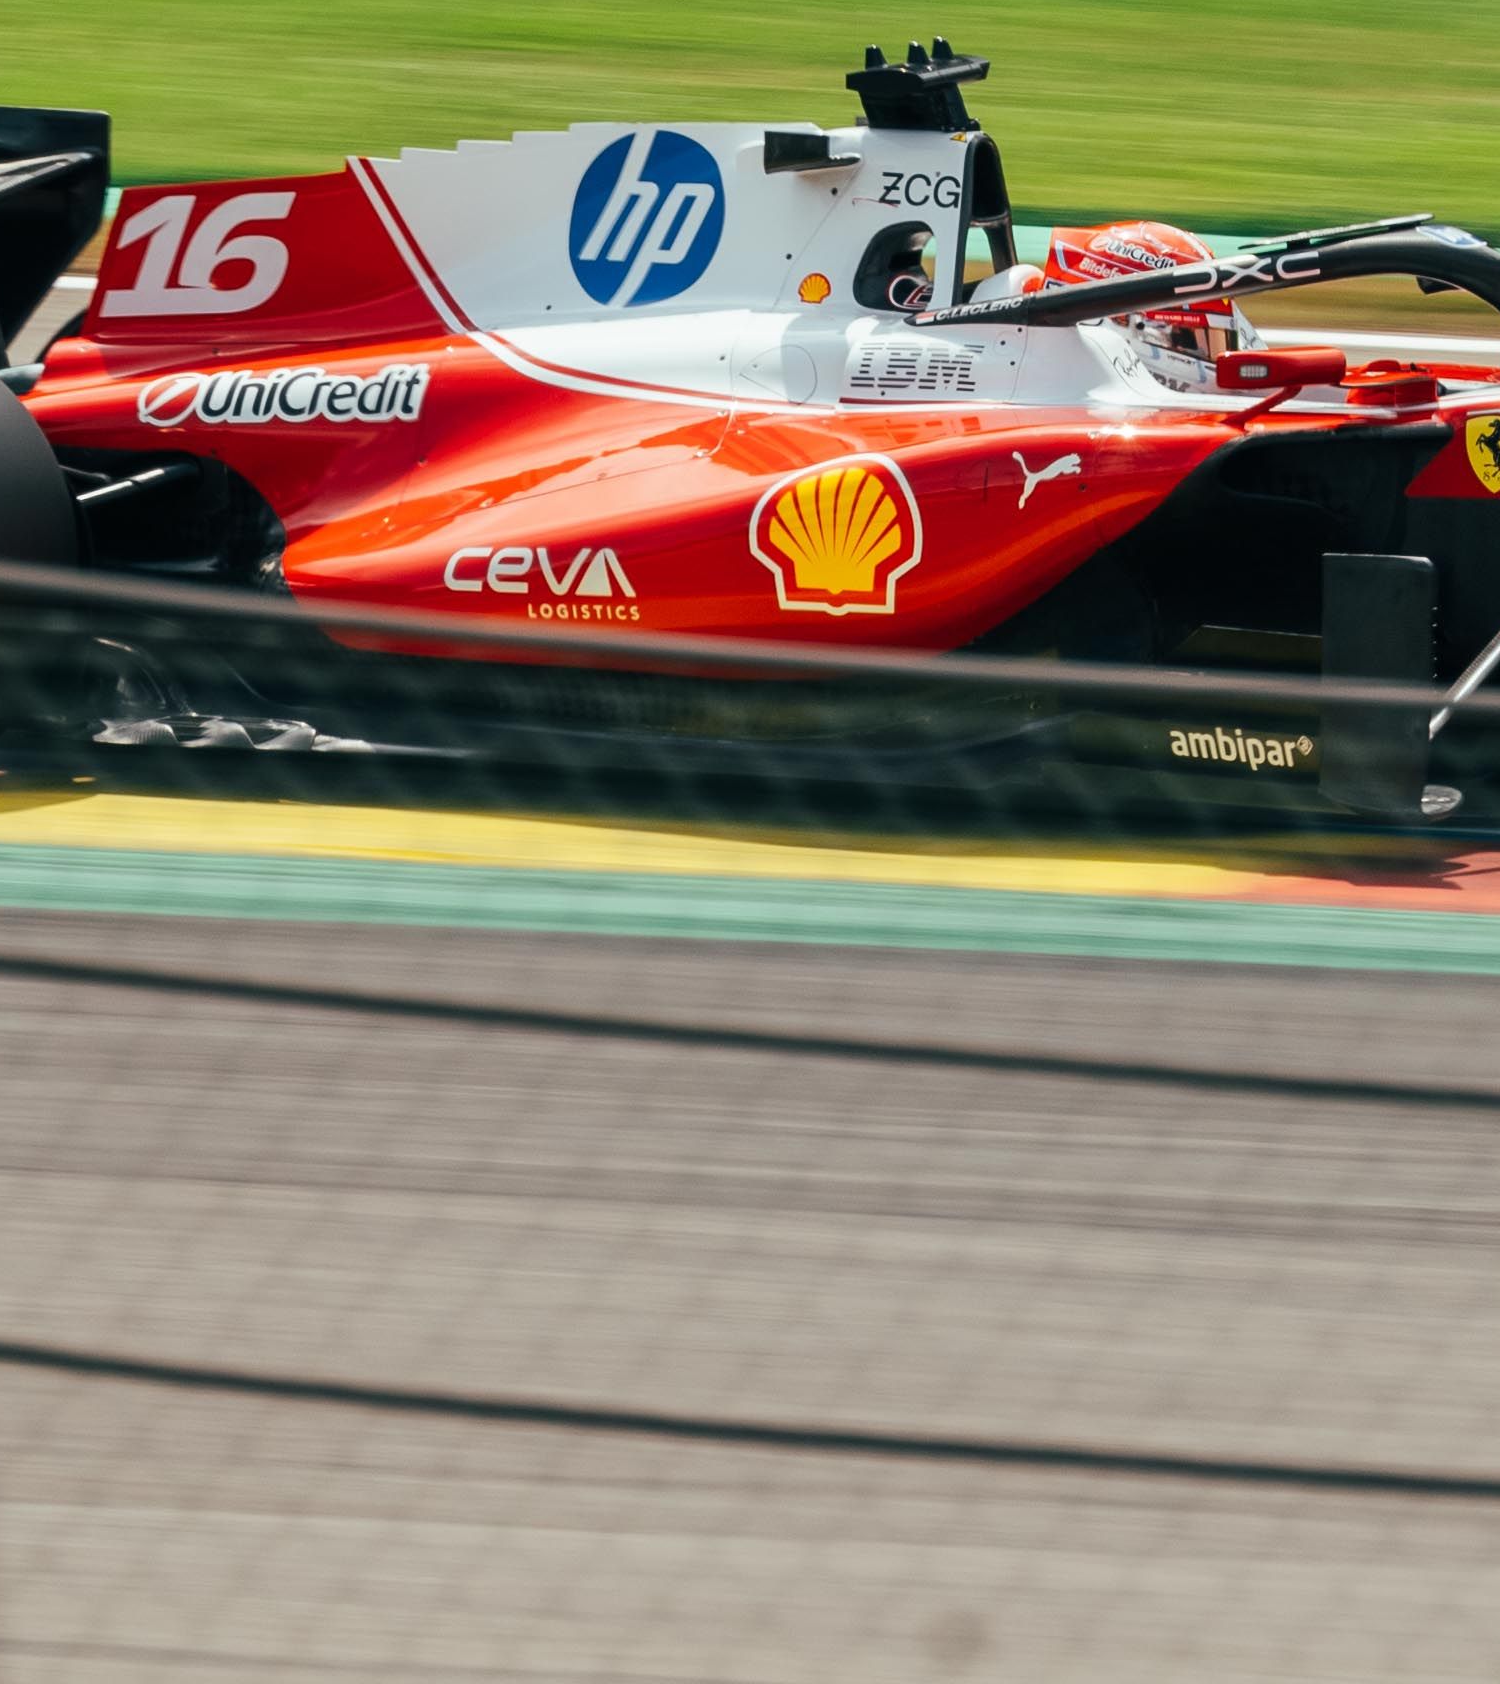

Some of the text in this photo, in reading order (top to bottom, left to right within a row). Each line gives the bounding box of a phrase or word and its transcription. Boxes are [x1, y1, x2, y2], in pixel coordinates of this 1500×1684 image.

[99, 191, 296, 317] 16
[849, 342, 985, 392] IBM
[201, 370, 421, 417] UniCredit
[527, 603, 640, 621] LOGISTICS
[1170, 727, 1296, 771] ambipar
